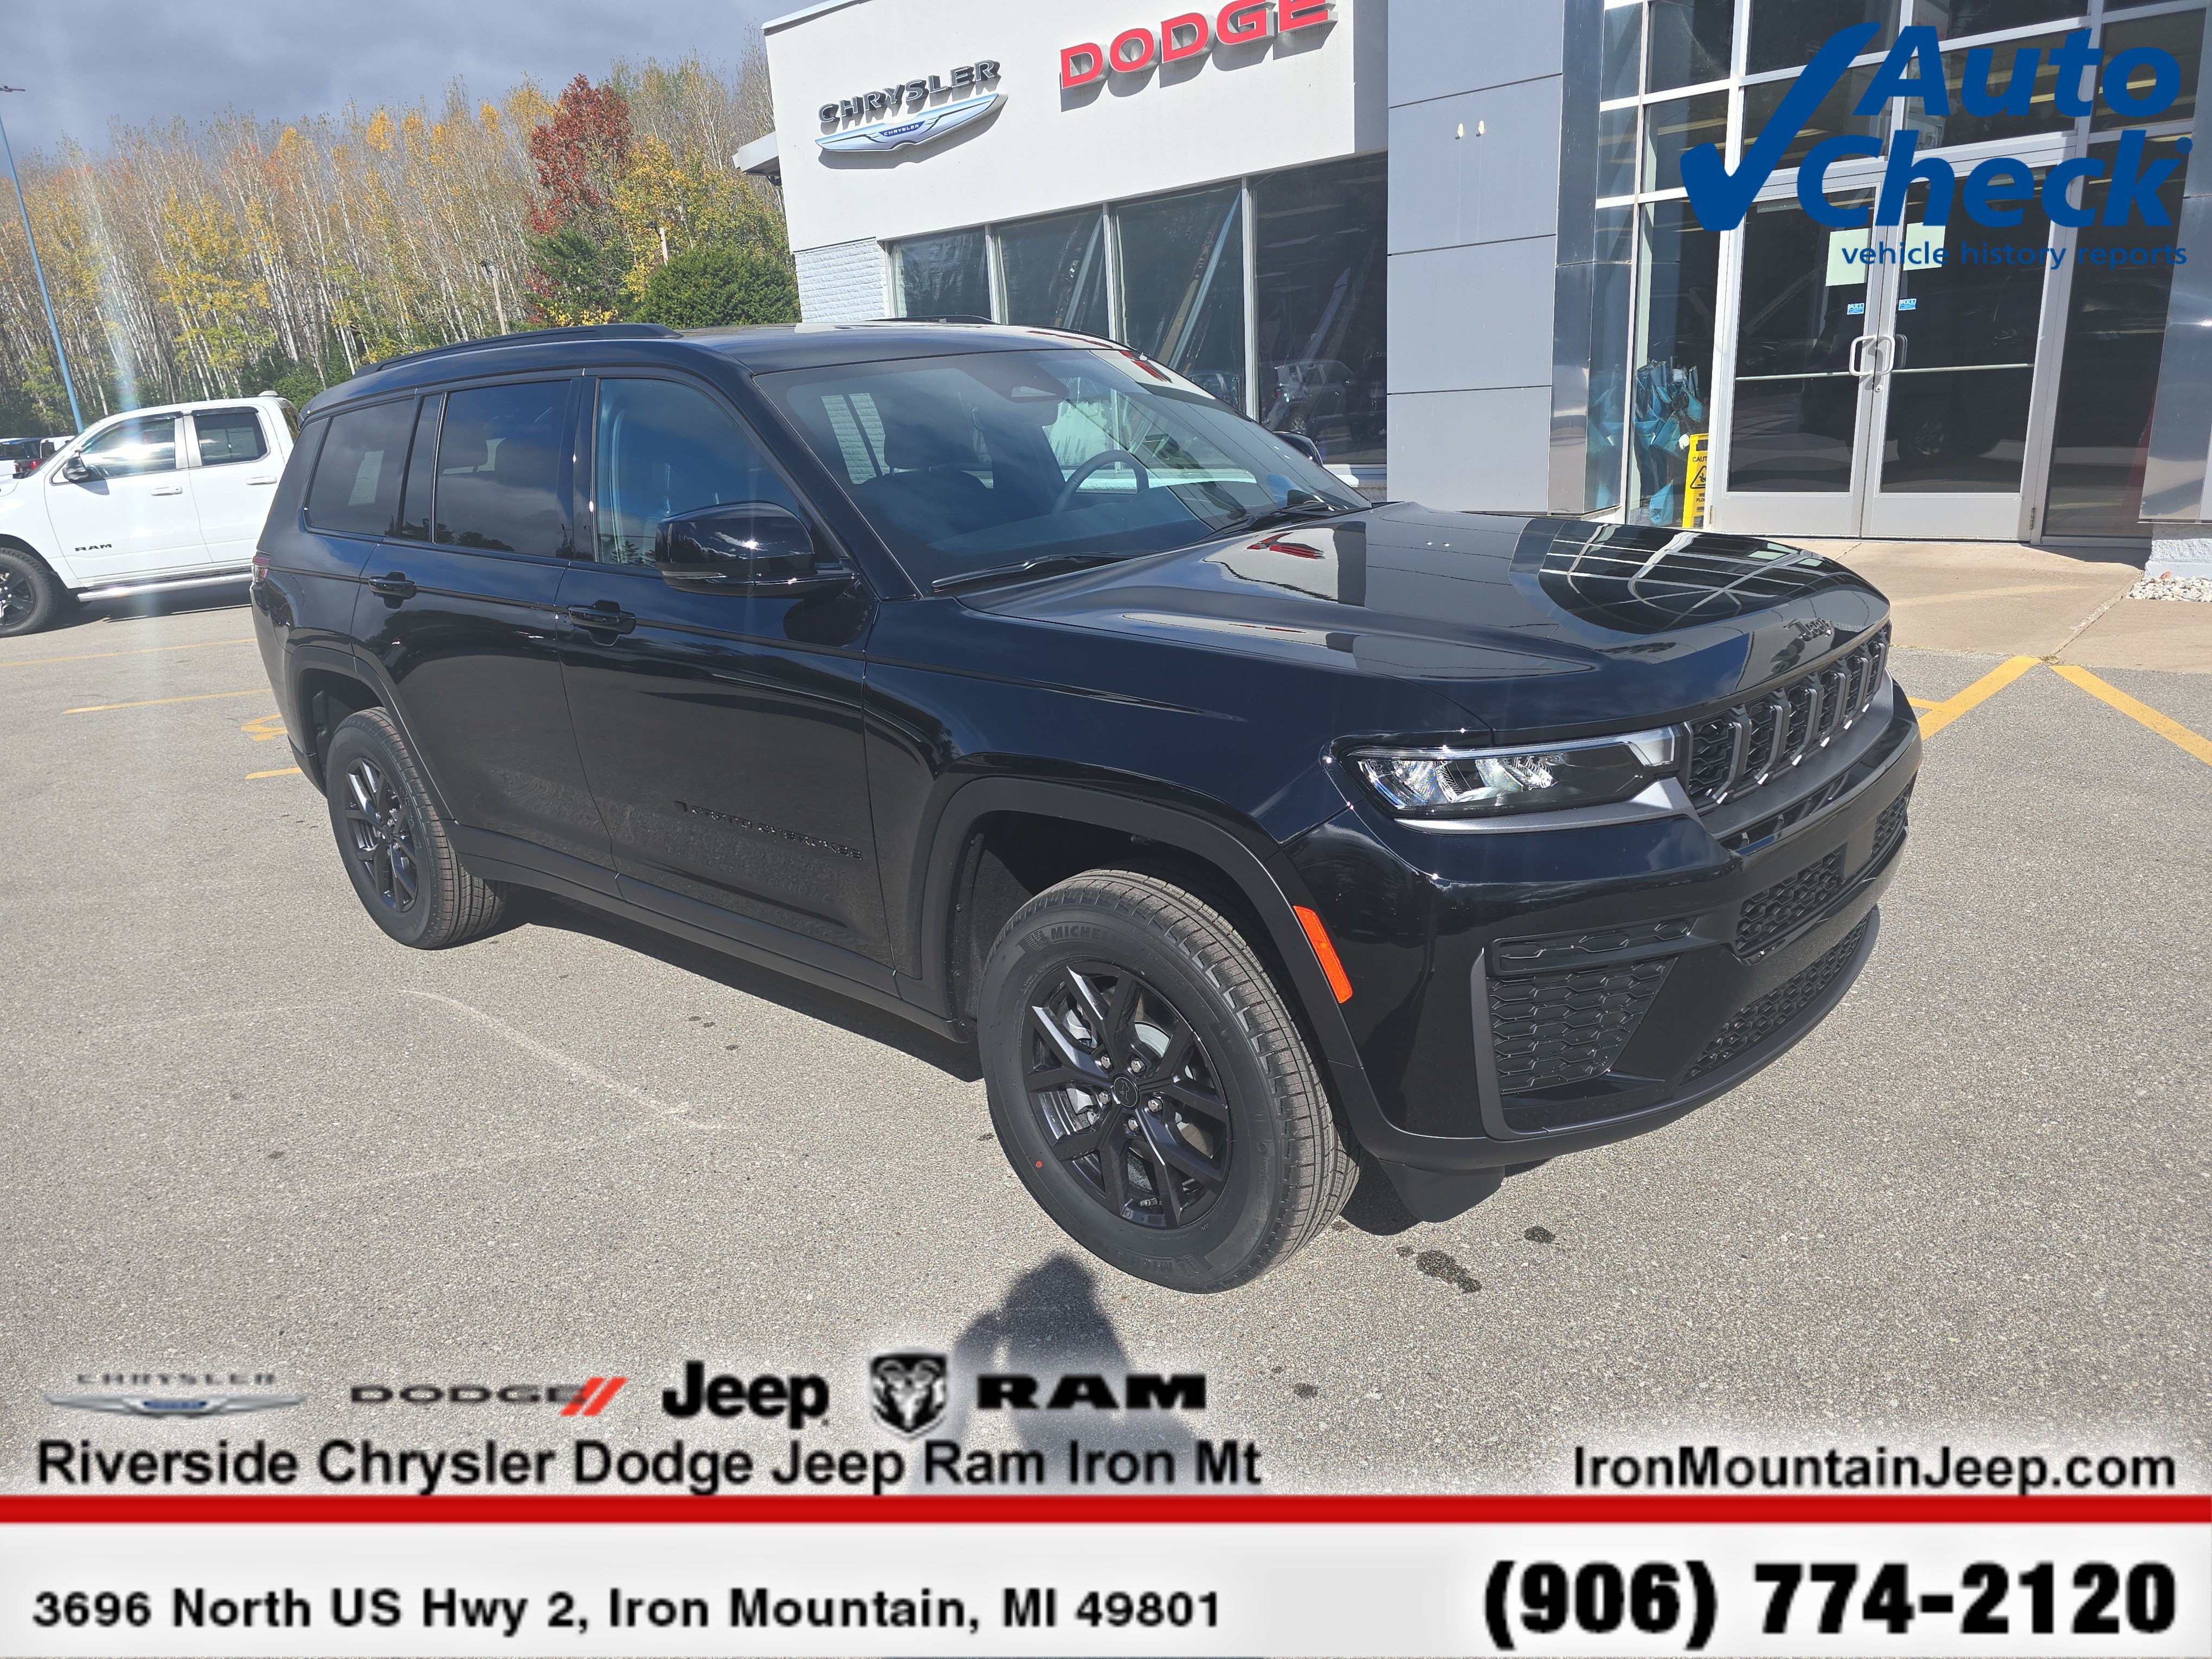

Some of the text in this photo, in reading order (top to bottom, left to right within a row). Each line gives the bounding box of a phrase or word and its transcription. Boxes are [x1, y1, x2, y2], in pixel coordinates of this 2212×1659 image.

[1060, 0, 1332, 89] DODGE
[818, 60, 1001, 123] CHRYSLER
[883, 124, 919, 136] CHRYSLER
[75, 544, 112, 552] RAM
